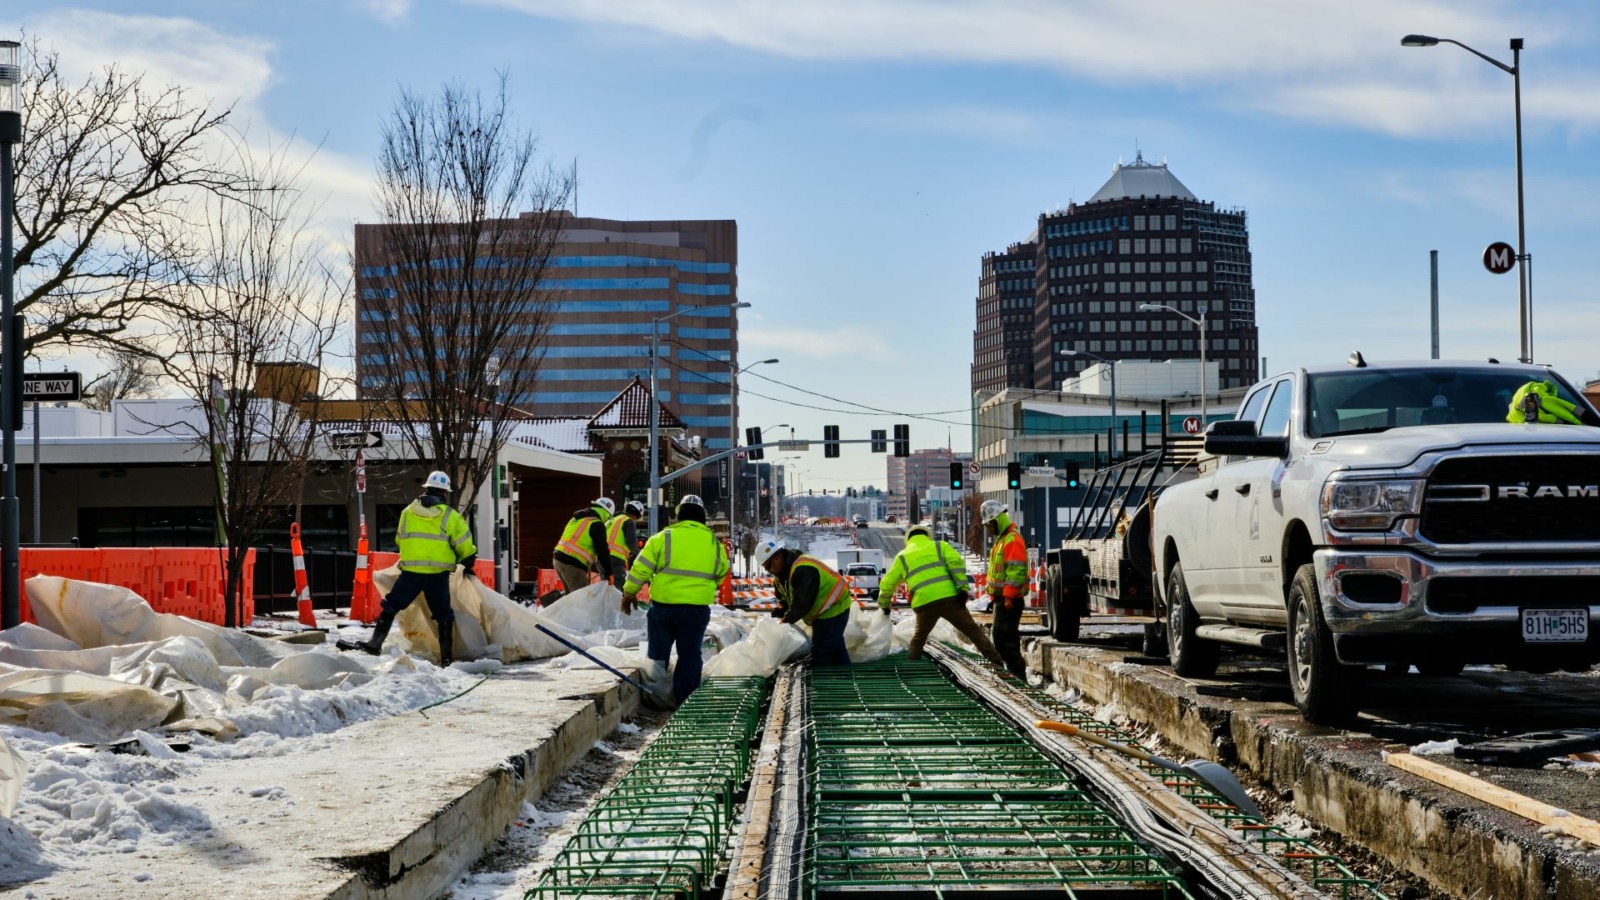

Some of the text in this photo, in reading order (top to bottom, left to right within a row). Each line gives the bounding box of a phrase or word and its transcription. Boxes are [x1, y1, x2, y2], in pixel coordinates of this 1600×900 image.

[1490, 248, 1508, 268] M
[25, 381, 70, 393] NE WAY
[1187, 420, 1198, 431] M
[1498, 485, 1598, 498] RAM
[1526, 616, 1585, 634] 81H 5HS
